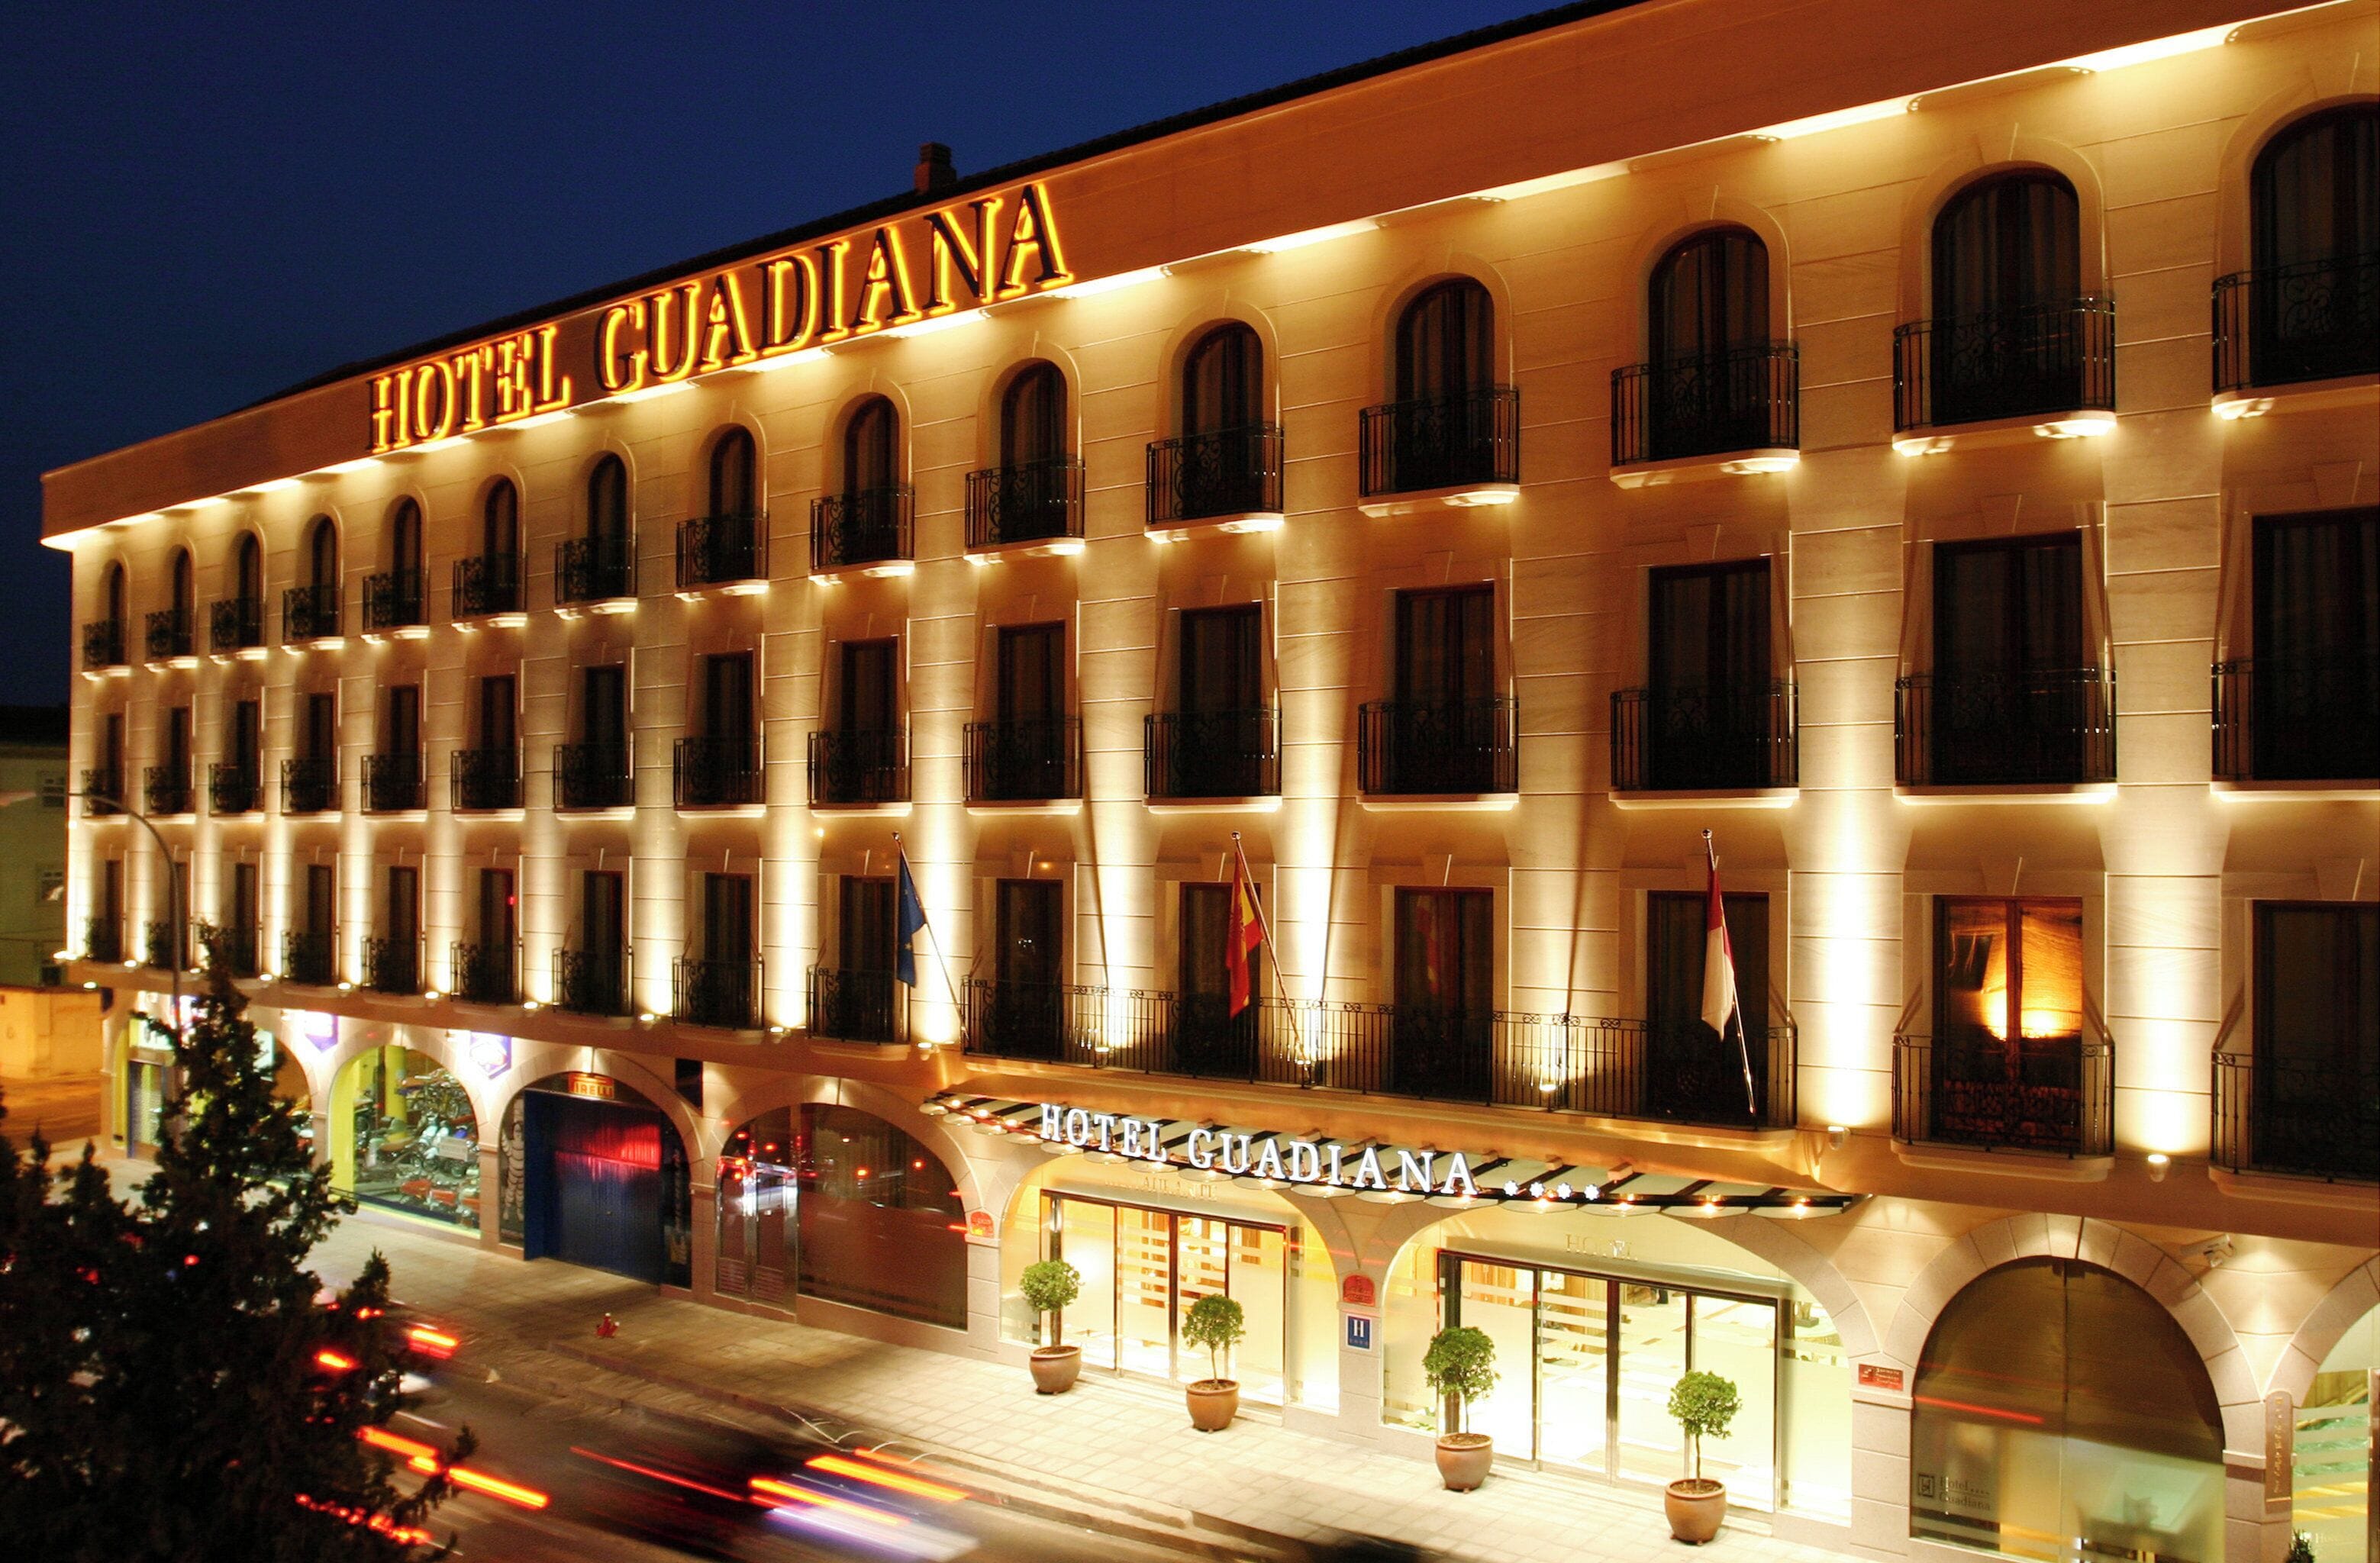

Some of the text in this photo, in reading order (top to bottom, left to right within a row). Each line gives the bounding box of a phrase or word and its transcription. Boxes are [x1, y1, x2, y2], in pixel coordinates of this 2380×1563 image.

[366, 182, 1073, 453] HOTEL GUADIANA
[1040, 1103, 1479, 1195] HOTEL GUADIANA
[1353, 1319, 1365, 1338] H
